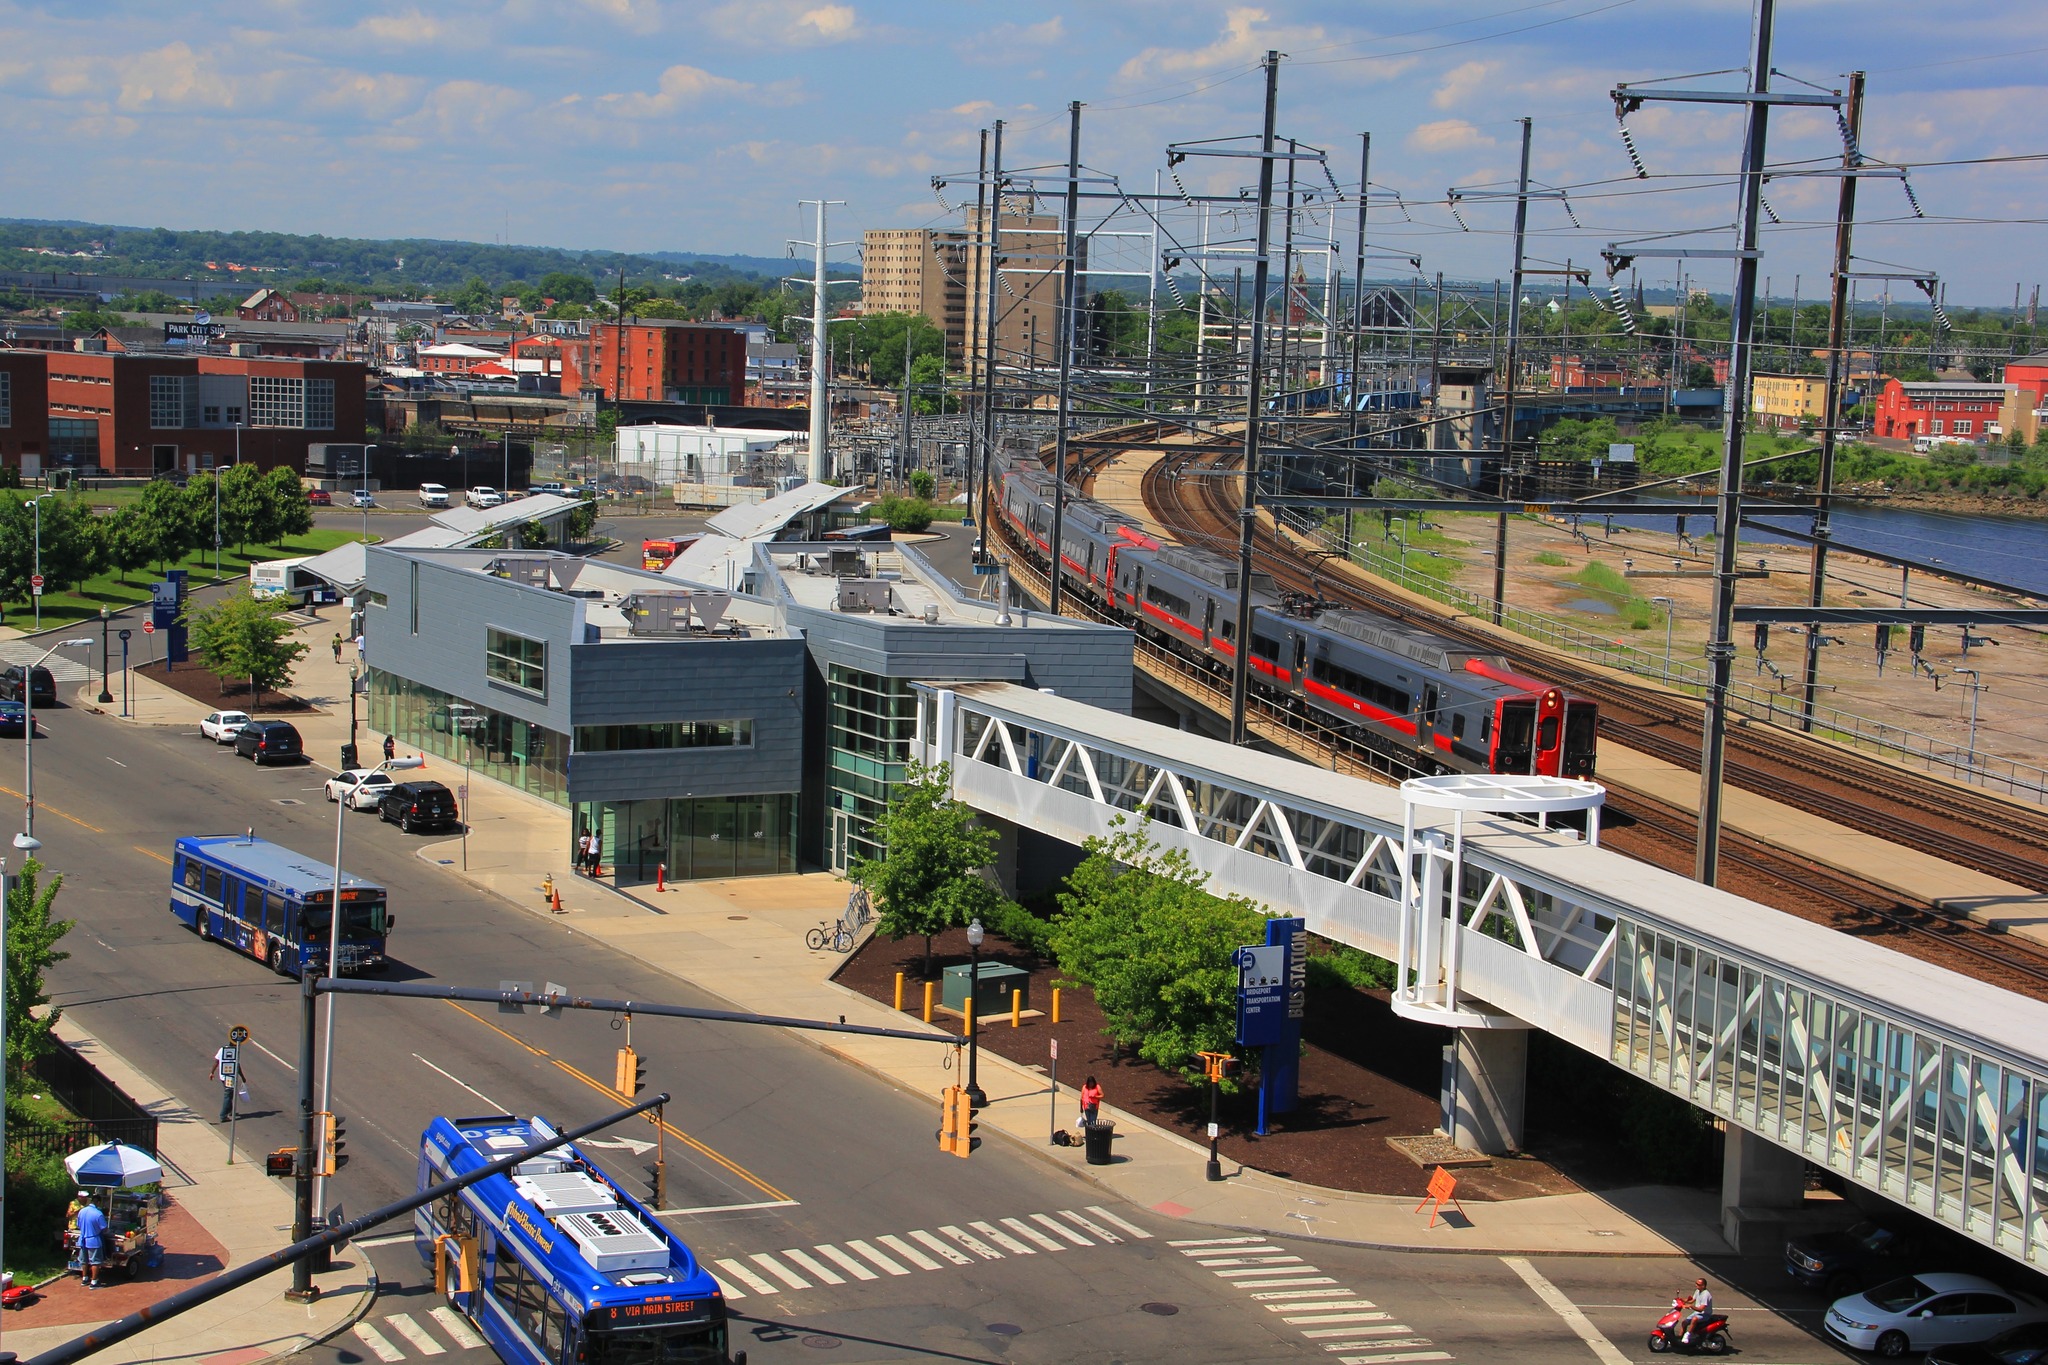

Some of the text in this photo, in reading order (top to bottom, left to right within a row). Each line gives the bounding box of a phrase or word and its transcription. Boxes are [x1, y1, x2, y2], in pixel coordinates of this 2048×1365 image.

[169, 324, 188, 334] PARK
[191, 325, 208, 334] CITY
[1526, 504, 1549, 513] 779A
[316, 893, 324, 902] 13
[1290, 931, 1307, 988] STATION
[1247, 996, 1280, 1004] TRANSPORTATION
[1288, 992, 1304, 1017] BUS
[1246, 1006, 1261, 1014] CENTER
[231, 1029, 247, 1039] gbt
[610, 1300, 695, 1319] 8 VIA MAIN STREET
